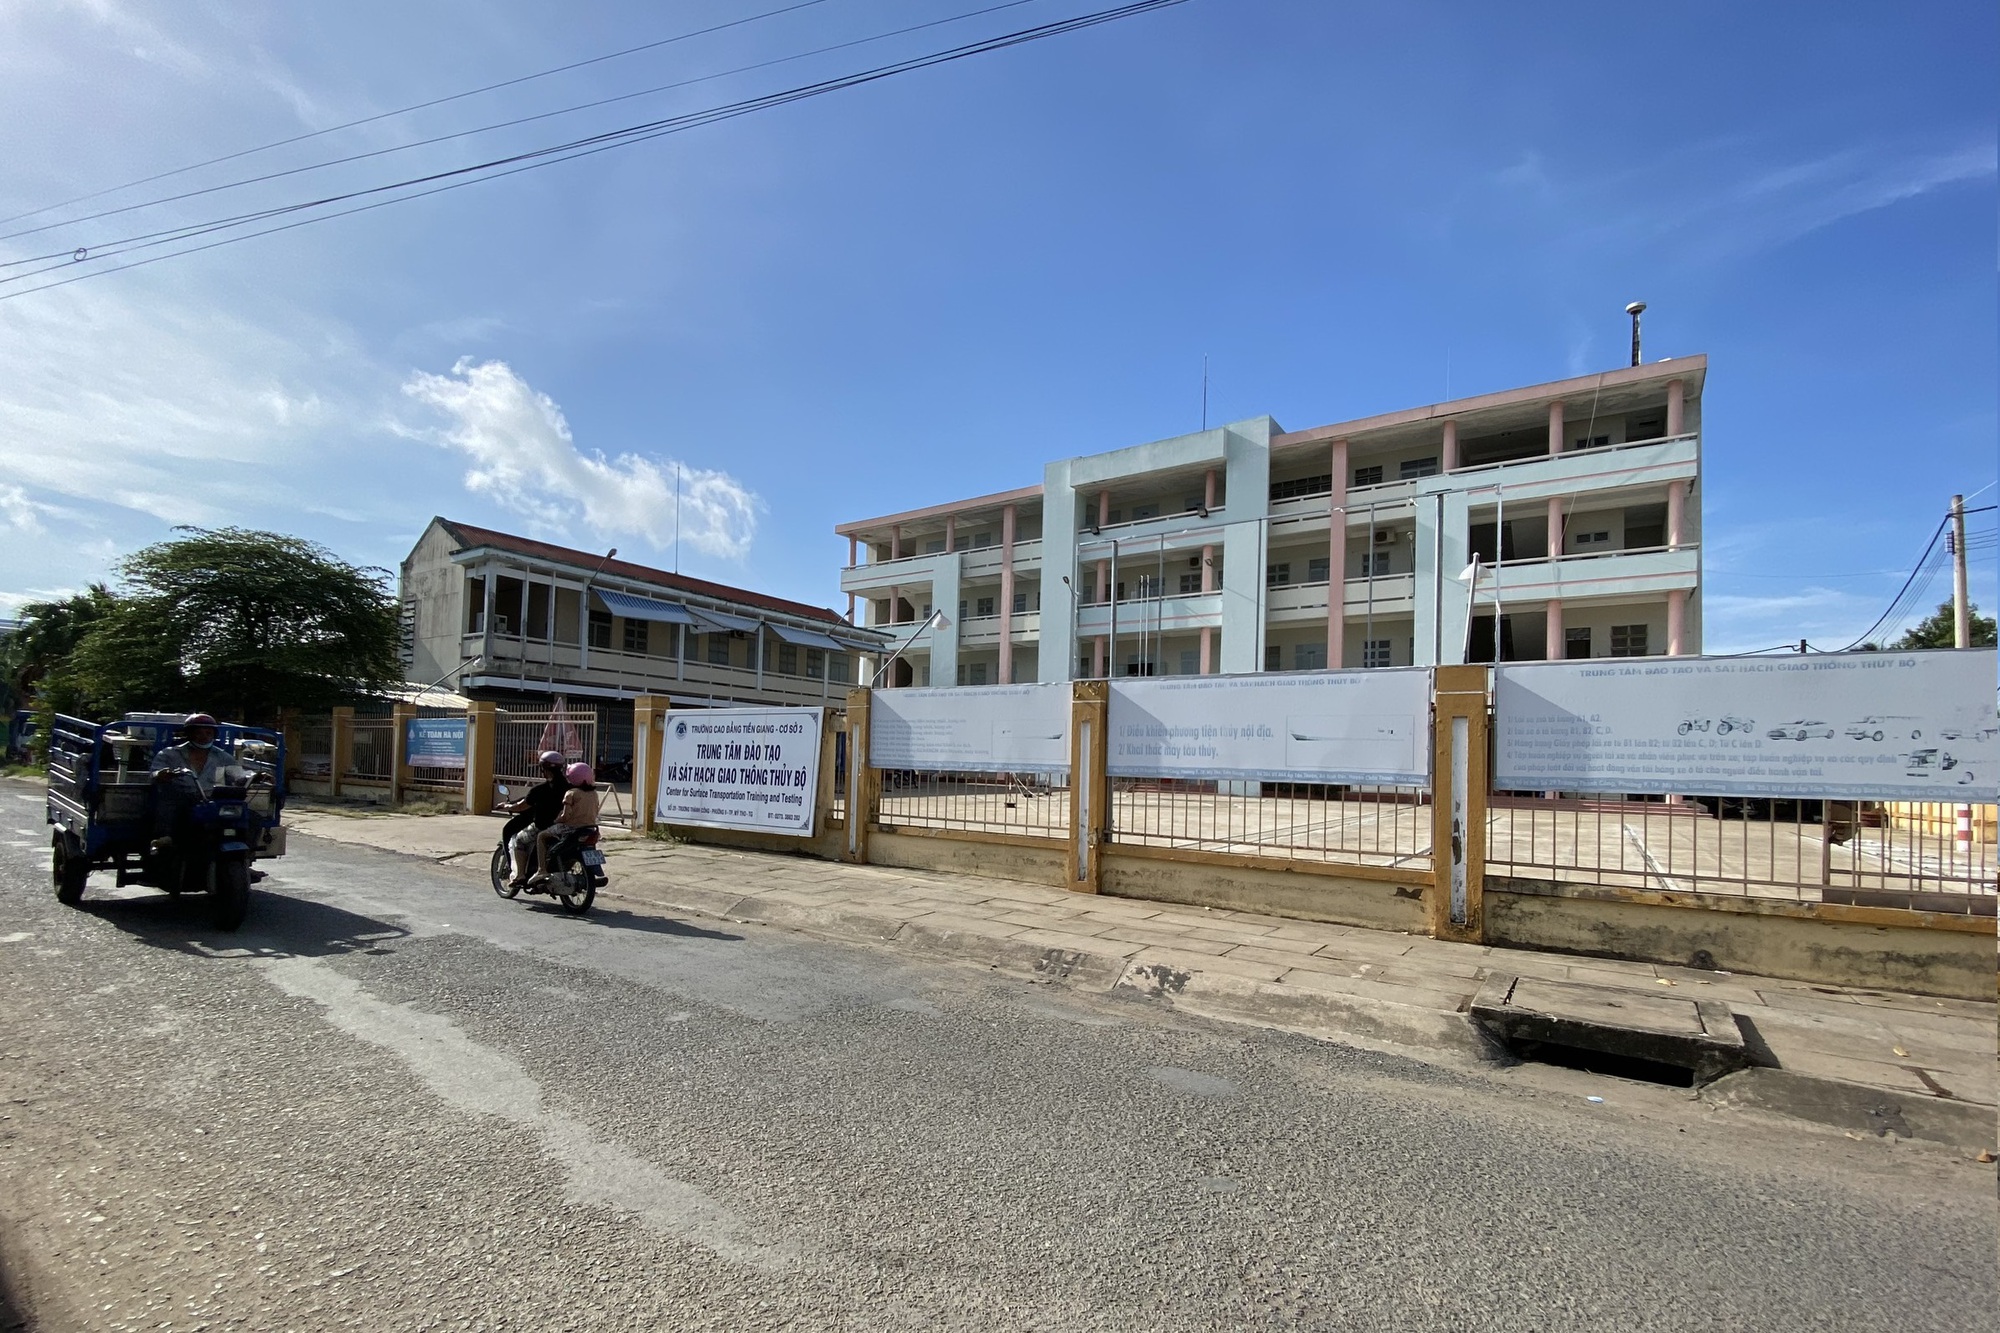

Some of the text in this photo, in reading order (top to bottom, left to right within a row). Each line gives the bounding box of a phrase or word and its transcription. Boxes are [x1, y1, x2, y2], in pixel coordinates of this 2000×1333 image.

[1778, 663, 1810, 672] GIAO
[692, 724, 712, 733] TRƯỜNG
[756, 725, 774, 733] GIANG
[799, 725, 803, 733] 2
[1202, 724, 1217, 740] tiện
[1240, 724, 1254, 740] nội
[1126, 744, 1143, 755] Khai
[1731, 739, 1738, 748] C
[697, 740, 781, 764] TRUNG TÂM ĐÀO TẠO
[668, 762, 806, 790] VÀ SÁT HẠCH GIAO THÔNG THỦY BỘ
[666, 786, 681, 796] Center
[690, 788, 708, 798] Surface
[710, 789, 746, 801] Transportation
[747, 791, 768, 804] Training
[769, 793, 780, 803] and
[782, 793, 802, 806] Testing
